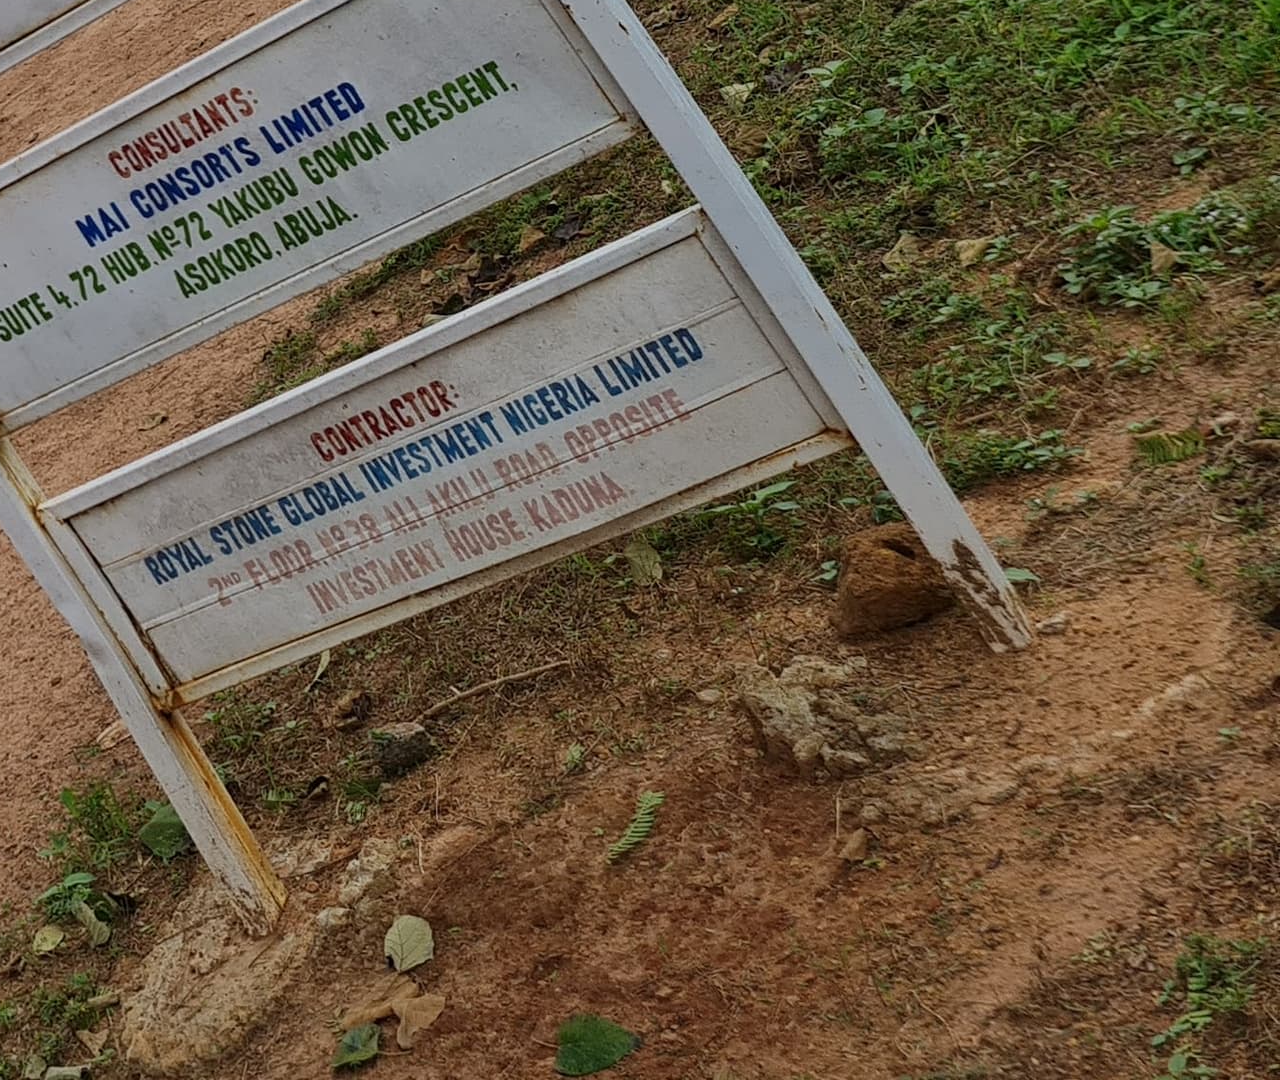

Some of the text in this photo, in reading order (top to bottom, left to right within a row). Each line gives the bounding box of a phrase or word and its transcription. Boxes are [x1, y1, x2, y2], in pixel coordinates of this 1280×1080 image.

[68, 265, 107, 301] 72
[207, 167, 299, 229] YAKUBU
[298, 123, 390, 186] GOWON
[386, 61, 519, 142] CRESCENT,
[75, 202, 130, 248] MAI
[259, 83, 366, 155] LIMITED
[109, 88, 259, 179] CONSULTANTS:
[174, 195, 359, 299] ASOKORO, ABUJA.
[144, 326, 703, 585] ROYAL STONE GLOBAL INVESTMENT NIGERIA LIMITED
[310, 380, 460, 462] CONTRACTOR:
[208, 572, 241, 607] 2ND
[564, 388, 692, 463] OPPOSITE
[306, 539, 447, 615] INVESTMENT
